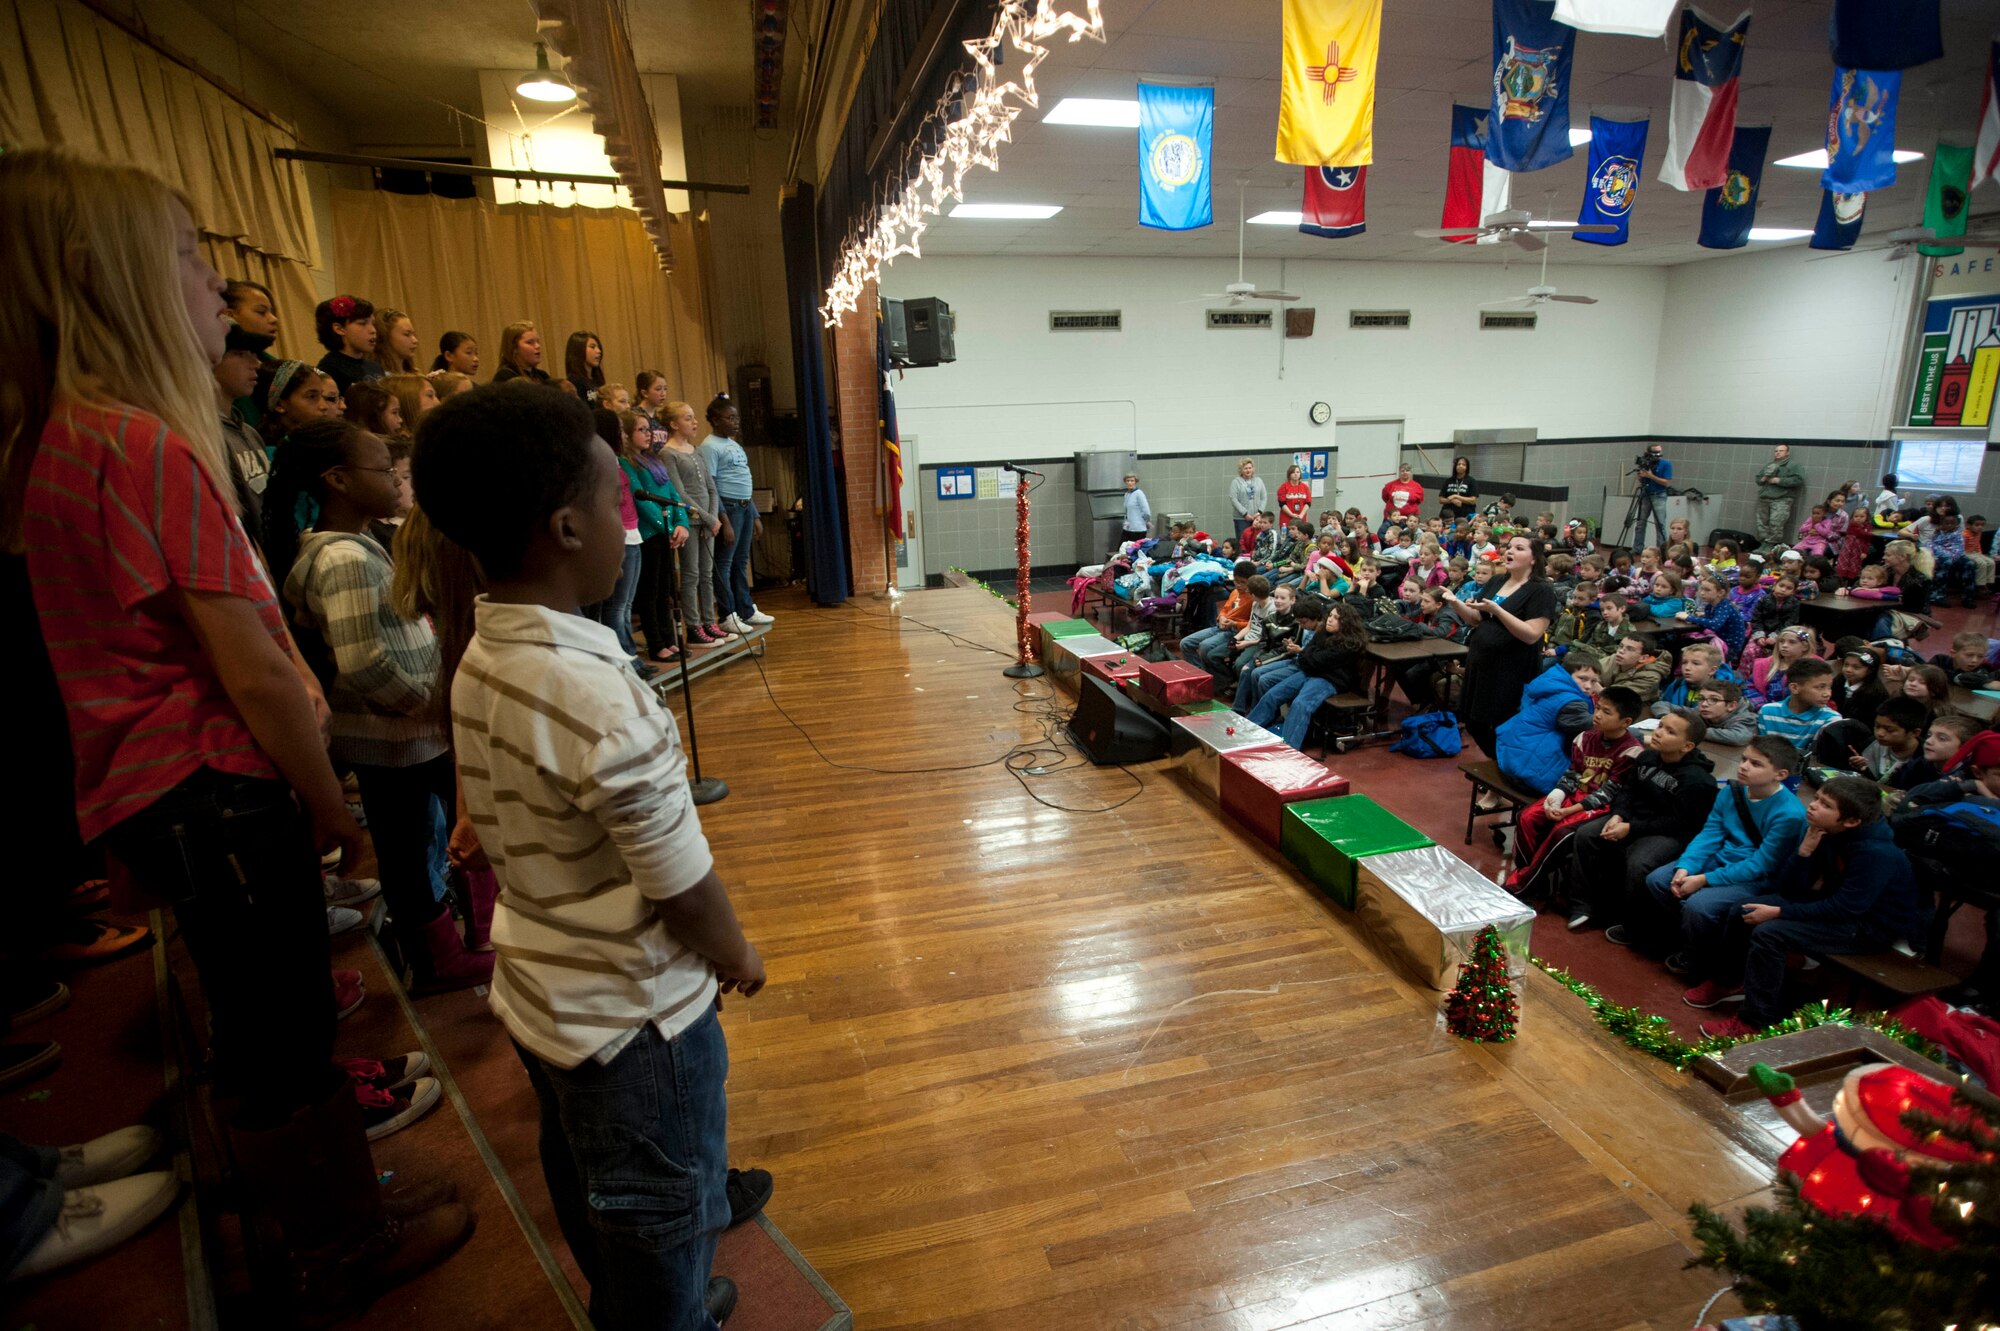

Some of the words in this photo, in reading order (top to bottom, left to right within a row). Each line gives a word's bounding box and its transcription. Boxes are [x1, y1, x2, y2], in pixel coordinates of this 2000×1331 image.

[1929, 353, 1940, 366] US
[1925, 366, 1936, 383] THE
[1923, 382, 1932, 393] IN
[1919, 393, 1931, 414] BEST
